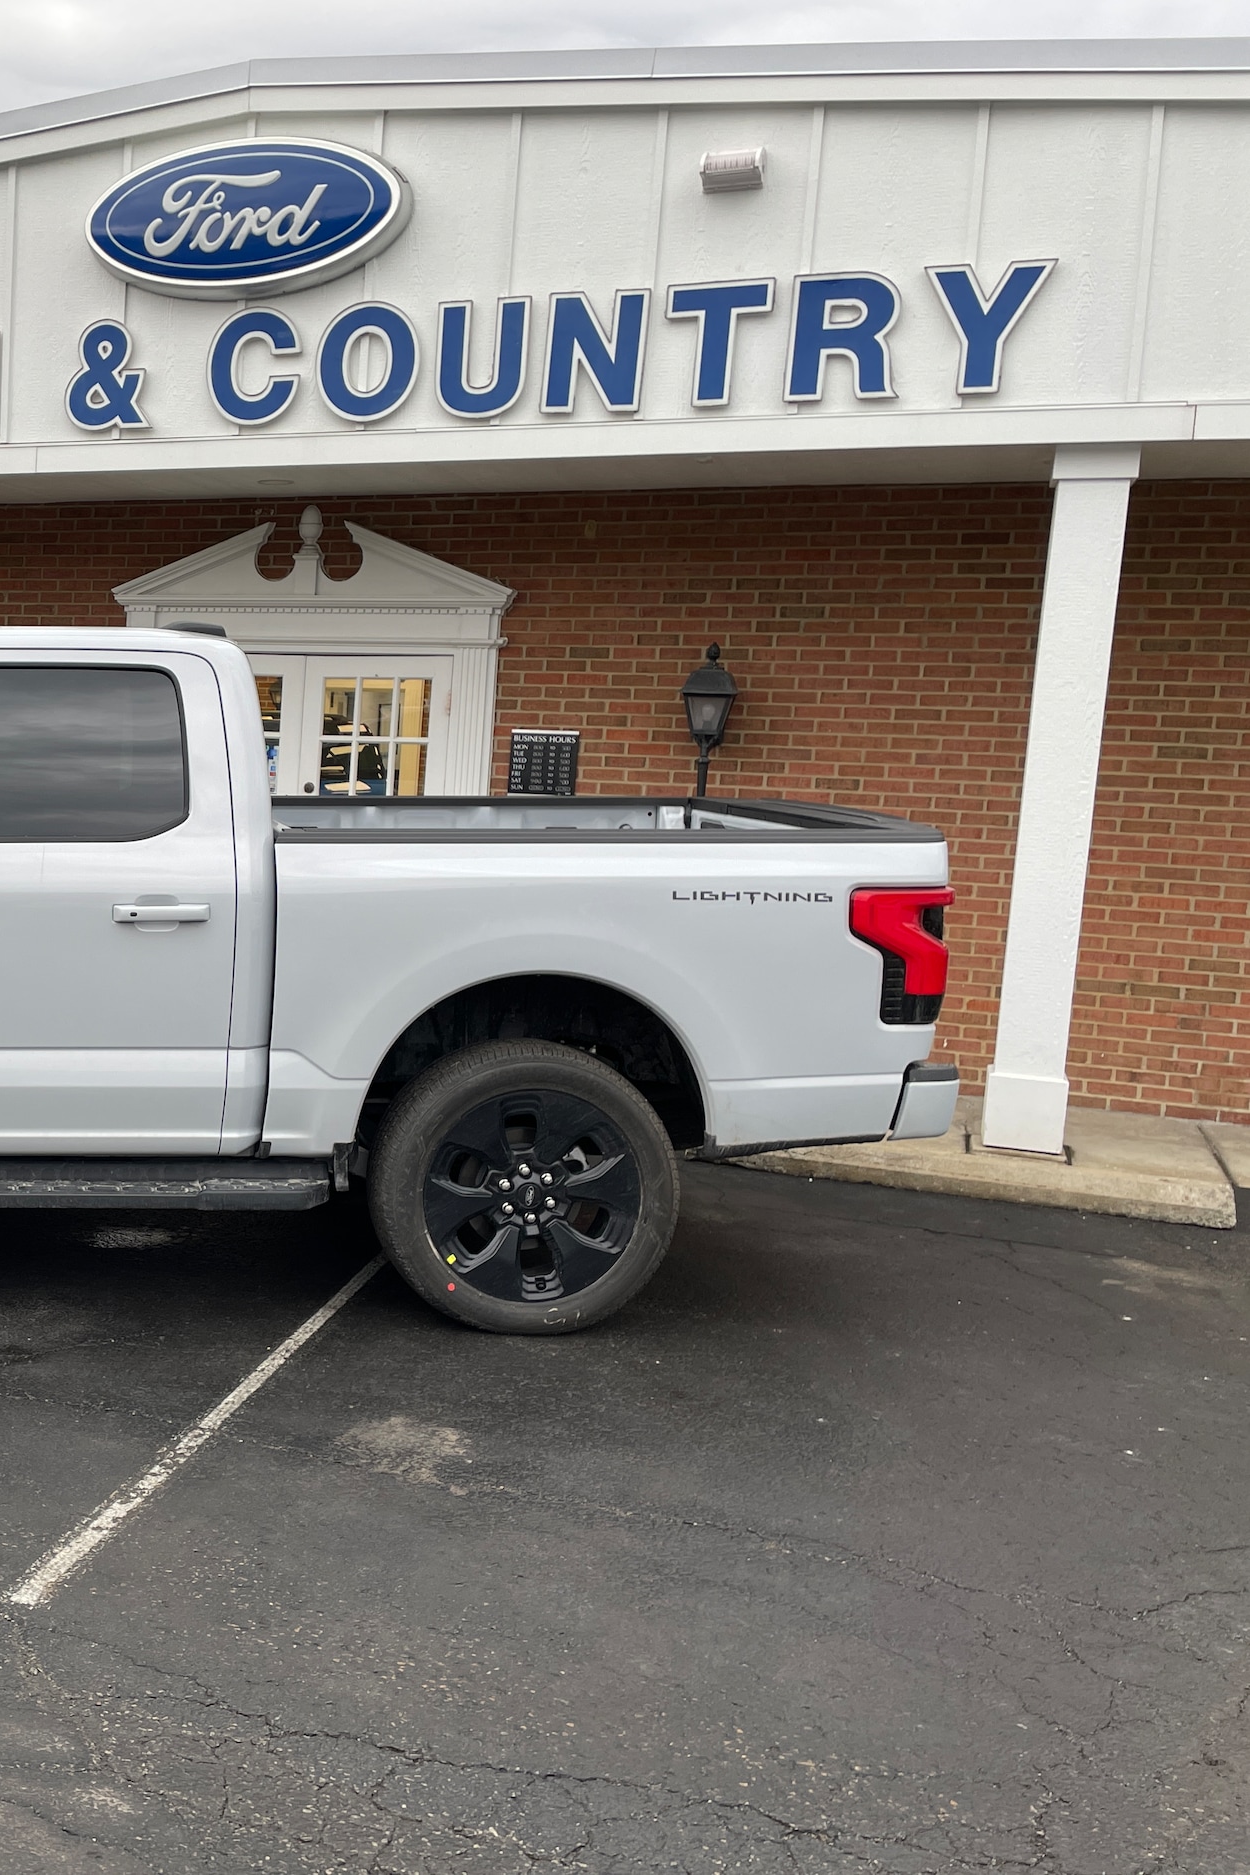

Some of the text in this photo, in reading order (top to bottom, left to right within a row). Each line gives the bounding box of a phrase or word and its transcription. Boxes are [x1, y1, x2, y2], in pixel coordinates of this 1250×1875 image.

[143, 169, 329, 258] Ford
[64, 318, 152, 432] &
[206, 258, 1059, 427] COUNTRY
[513, 734, 576, 744] BUSINESS HOURS
[672, 890, 834, 905] LIGHTNING
